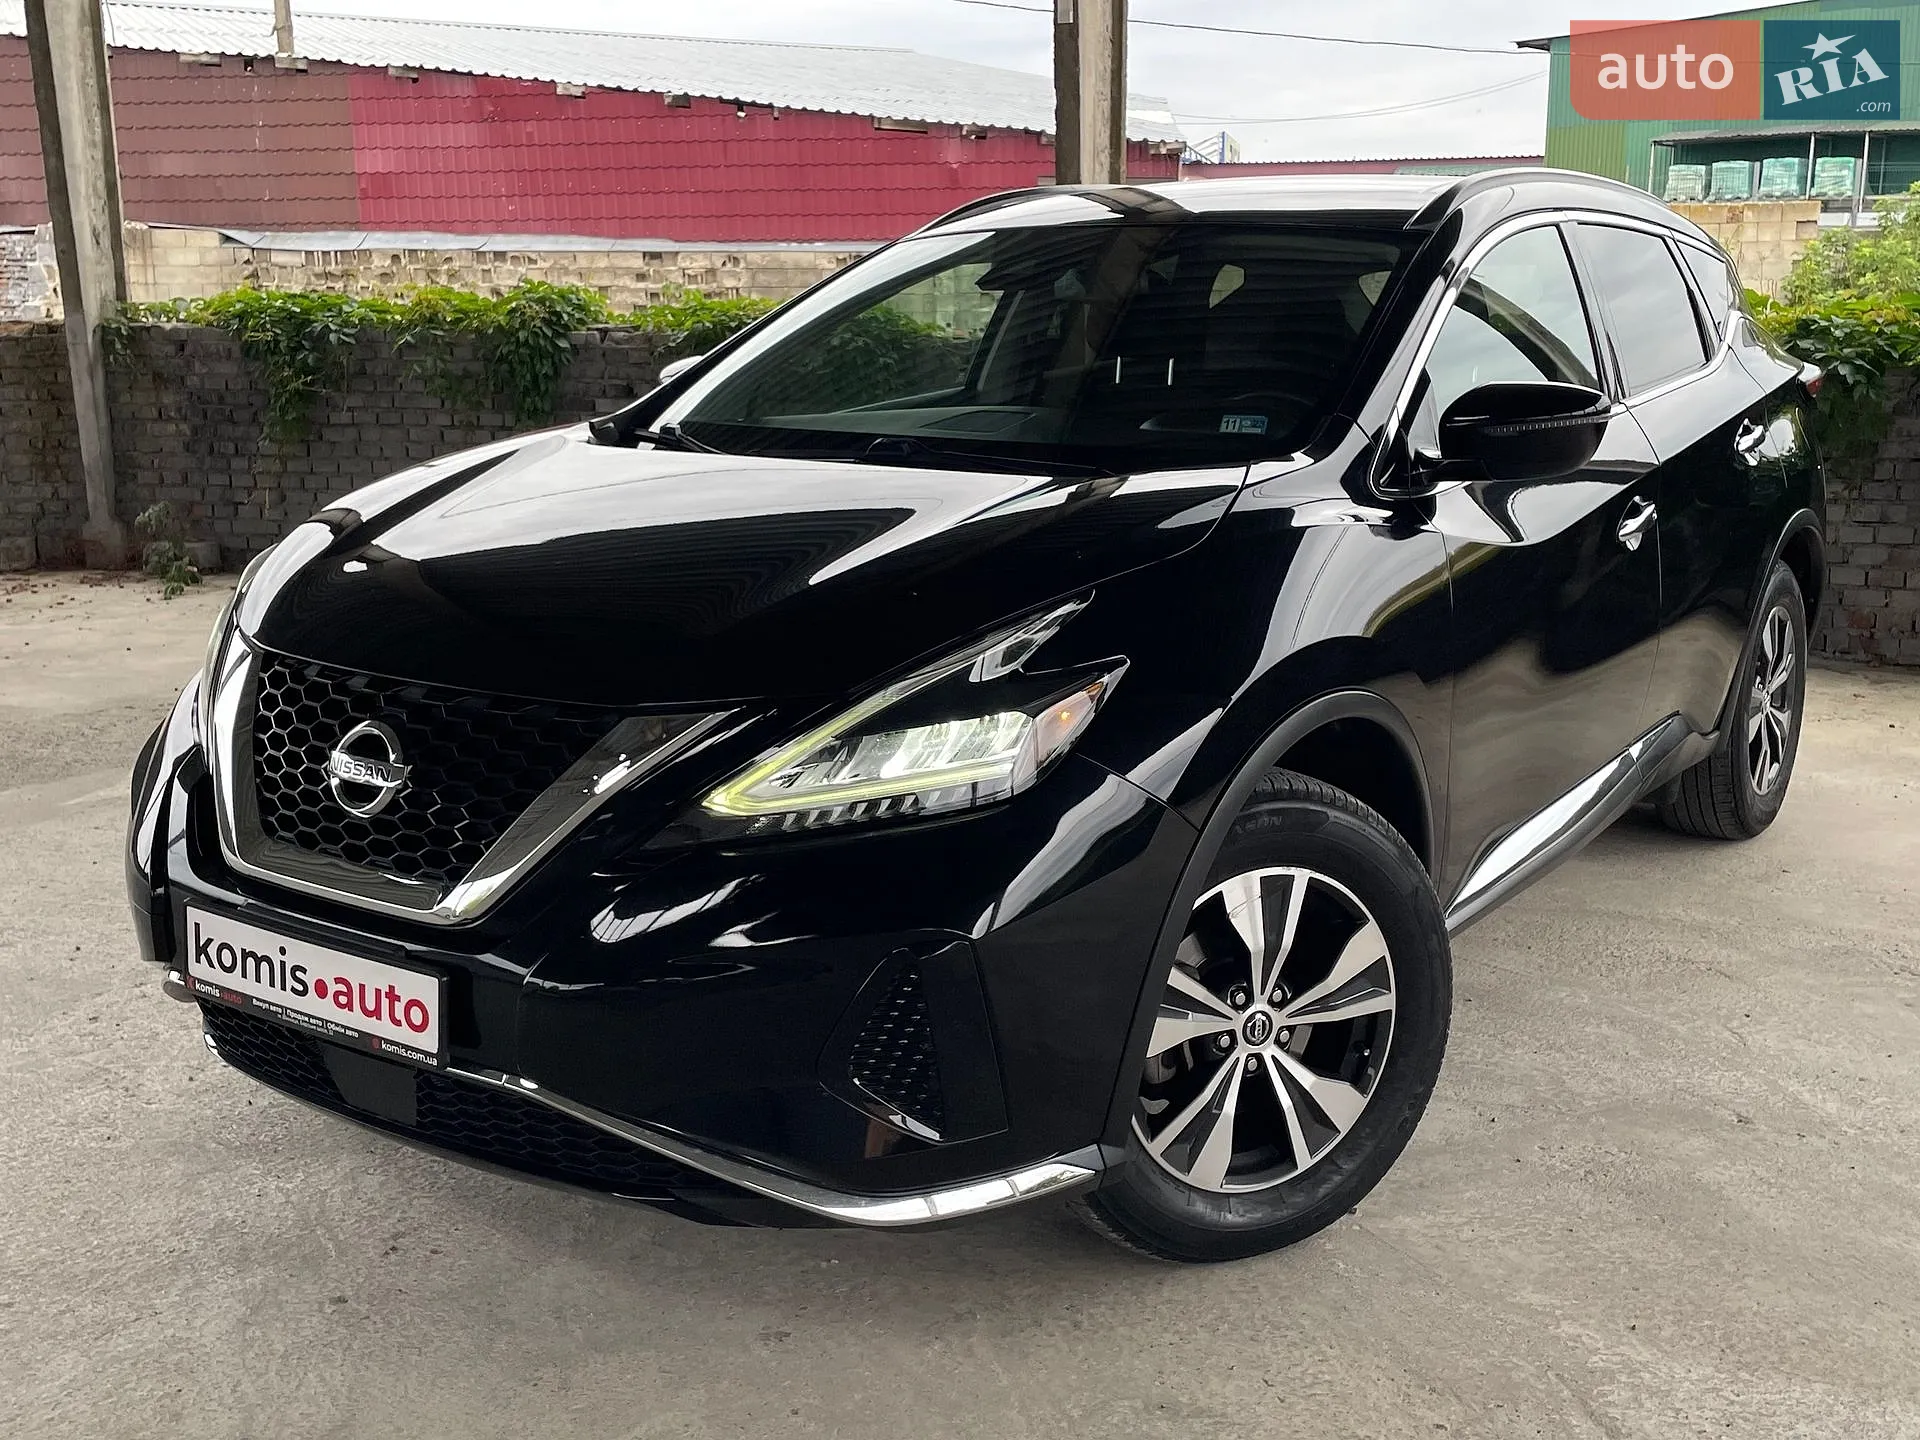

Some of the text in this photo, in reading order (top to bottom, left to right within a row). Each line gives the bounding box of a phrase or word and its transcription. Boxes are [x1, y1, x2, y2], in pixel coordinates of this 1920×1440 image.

[1223, 418, 1237, 430] 11
[329, 751, 393, 783] NISSAN
[381, 1039, 438, 1066] komis.com.ua
